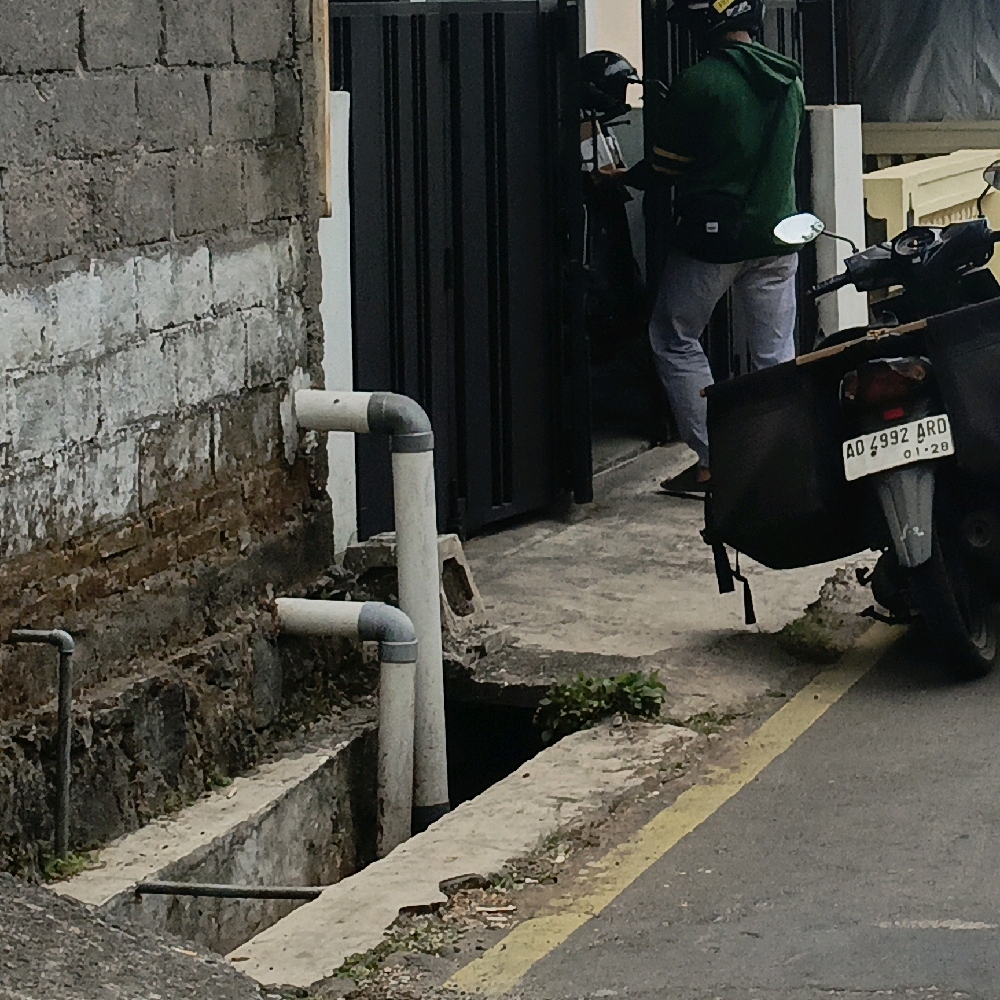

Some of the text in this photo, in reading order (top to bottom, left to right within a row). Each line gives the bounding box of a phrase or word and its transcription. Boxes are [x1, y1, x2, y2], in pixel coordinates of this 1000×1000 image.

[846, 417, 947, 459] AD 4992 ARD
